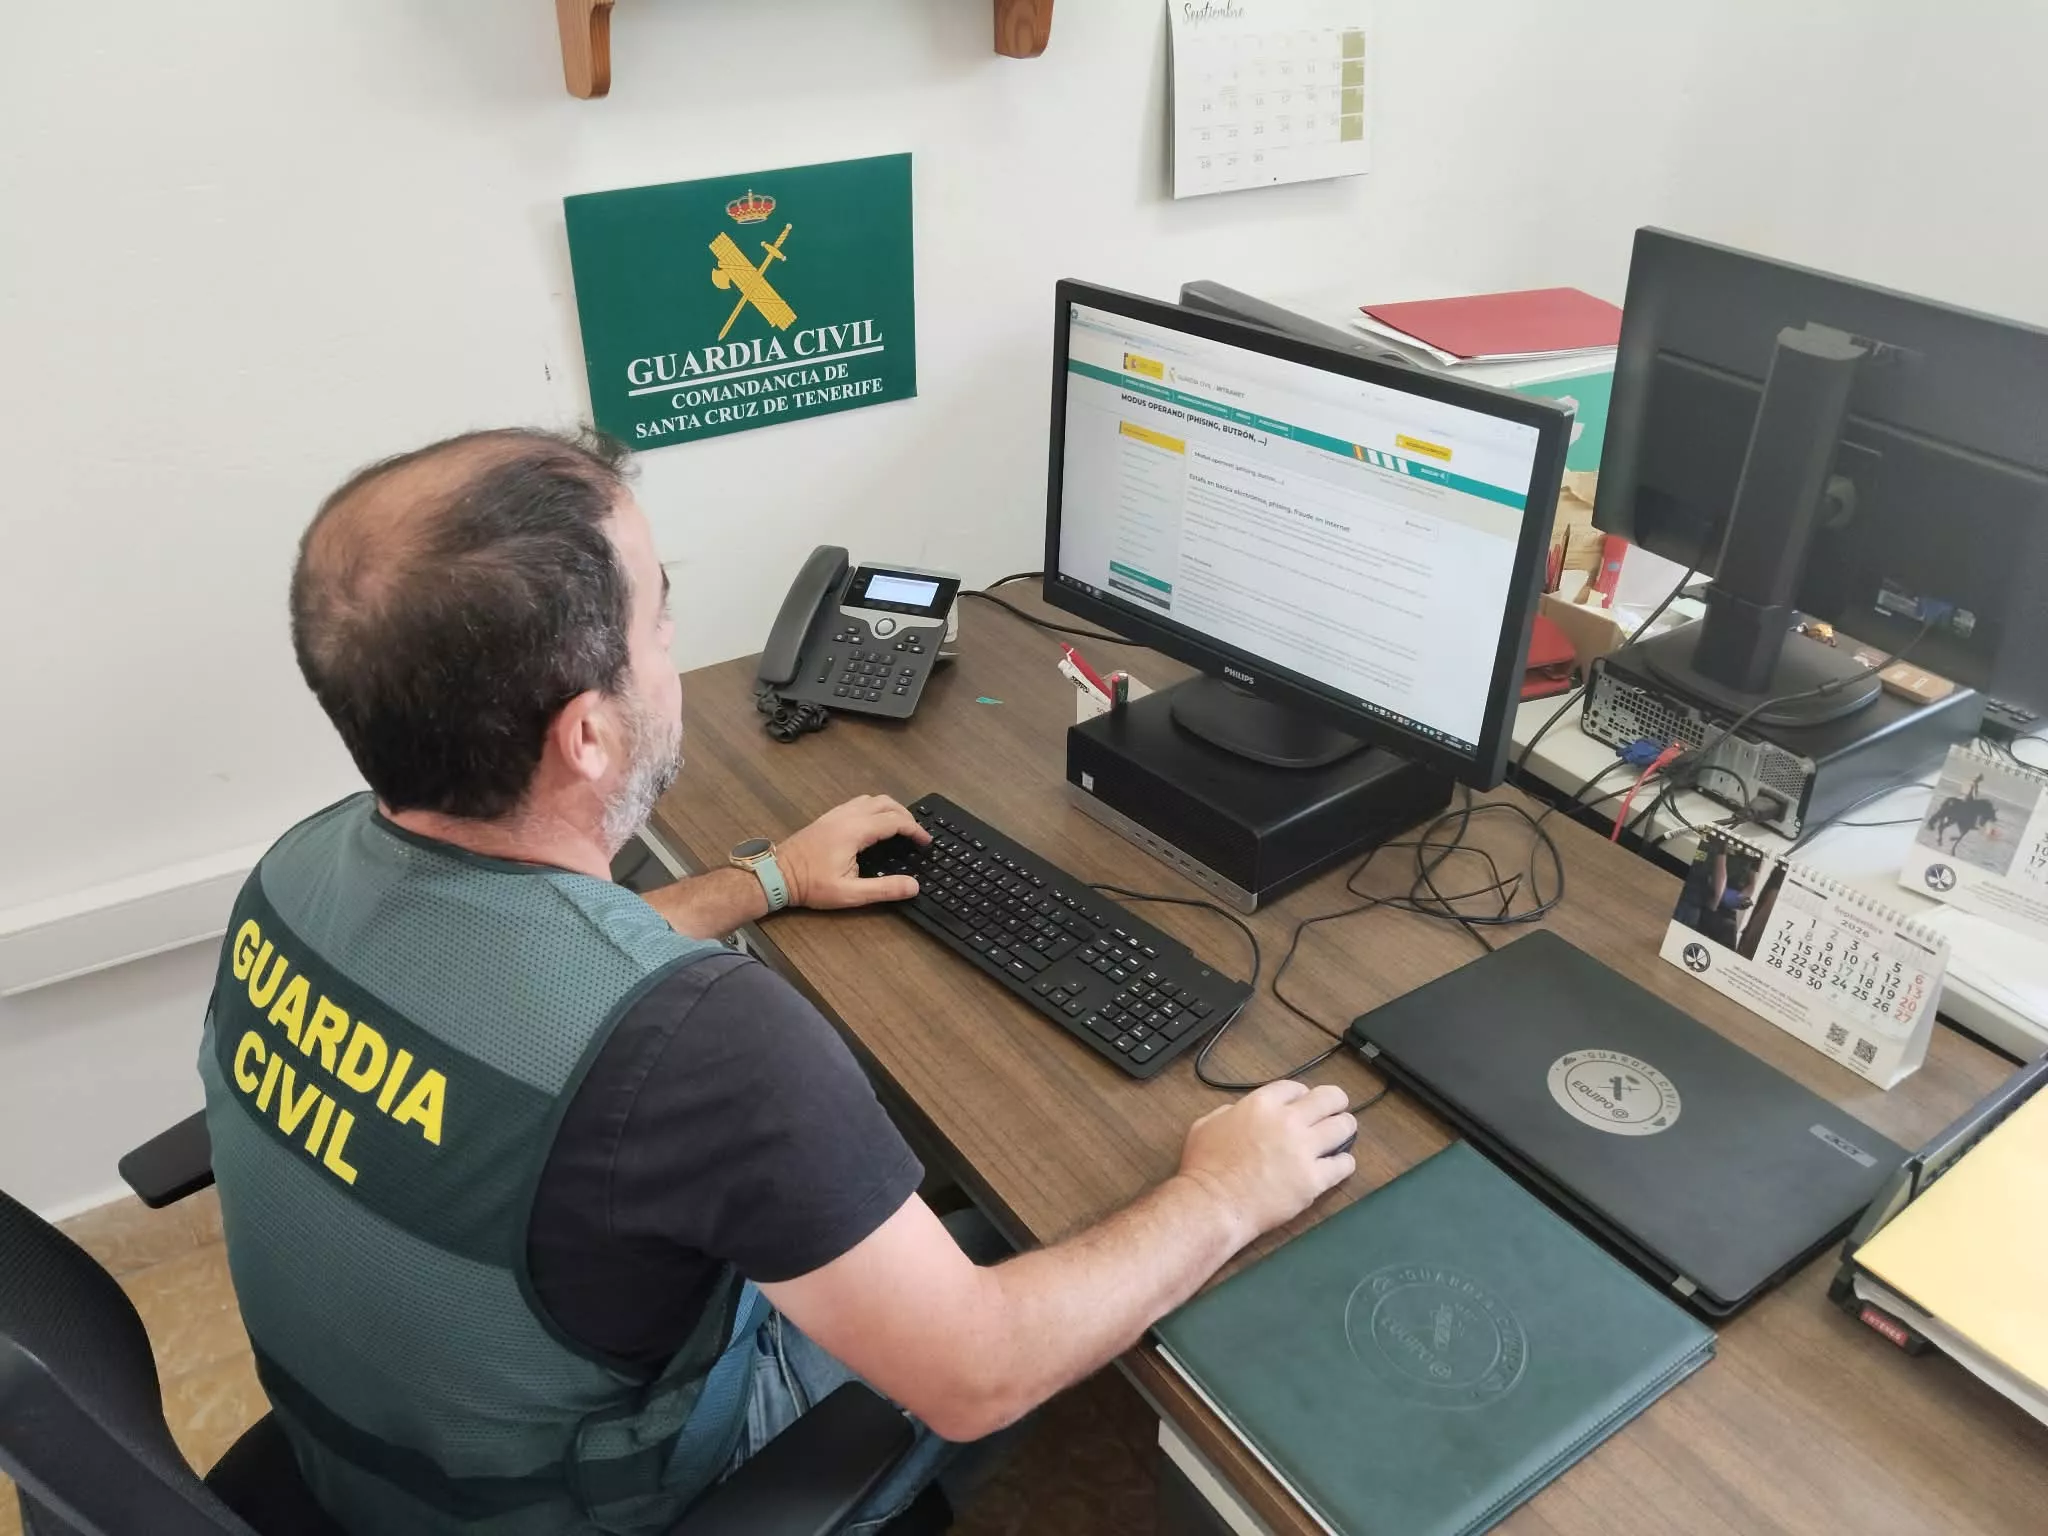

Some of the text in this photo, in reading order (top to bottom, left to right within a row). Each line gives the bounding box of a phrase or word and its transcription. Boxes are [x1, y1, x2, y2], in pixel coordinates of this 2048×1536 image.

[627, 319, 883, 386] GUARDIA CIVIL
[635, 378, 883, 439] SANTA CRUZ DE TENERIFE
[671, 363, 849, 410] COMANDANCIA DE
[1121, 393, 1147, 407] MODUS
[1148, 402, 1185, 420] OPERANDI
[1186, 414, 1221, 432] (PHISING,
[1189, 473, 1206, 484] Estafa
[1325, 519, 1350, 532] internet
[1224, 666, 1255, 685] PHILIPS
[2030, 855, 2047, 867] 17
[1766, 954, 1822, 990] 28 29 30
[1778, 930, 1791, 945] 14
[1798, 940, 1813, 956] 15
[1818, 951, 1833, 967] 16
[1859, 973, 1874, 989] 18
[1880, 985, 1896, 1000] 19
[1899, 996, 1917, 1012] 20
[1786, 920, 1795, 930] 7
[1825, 941, 1834, 952] 9
[1843, 950, 1858, 965] 10
[1885, 972, 1901, 989] 12
[1907, 984, 1923, 999] 13
[1811, 919, 1817, 929] 1
[1850, 940, 1859, 951] 3
[1871, 951, 1880, 962] 4
[1892, 962, 1902, 973] 5
[1915, 974, 1924, 985] 6
[1771, 942, 1912, 1024] 21 22 23 24 25 26 27
[233, 919, 447, 1146] GUARDIA
[234, 1031, 358, 1185] CIVIL
[1572, 1080, 1614, 1109] EQUIPO
[1587, 1052, 1678, 1110] GUARDIA CIVIL
